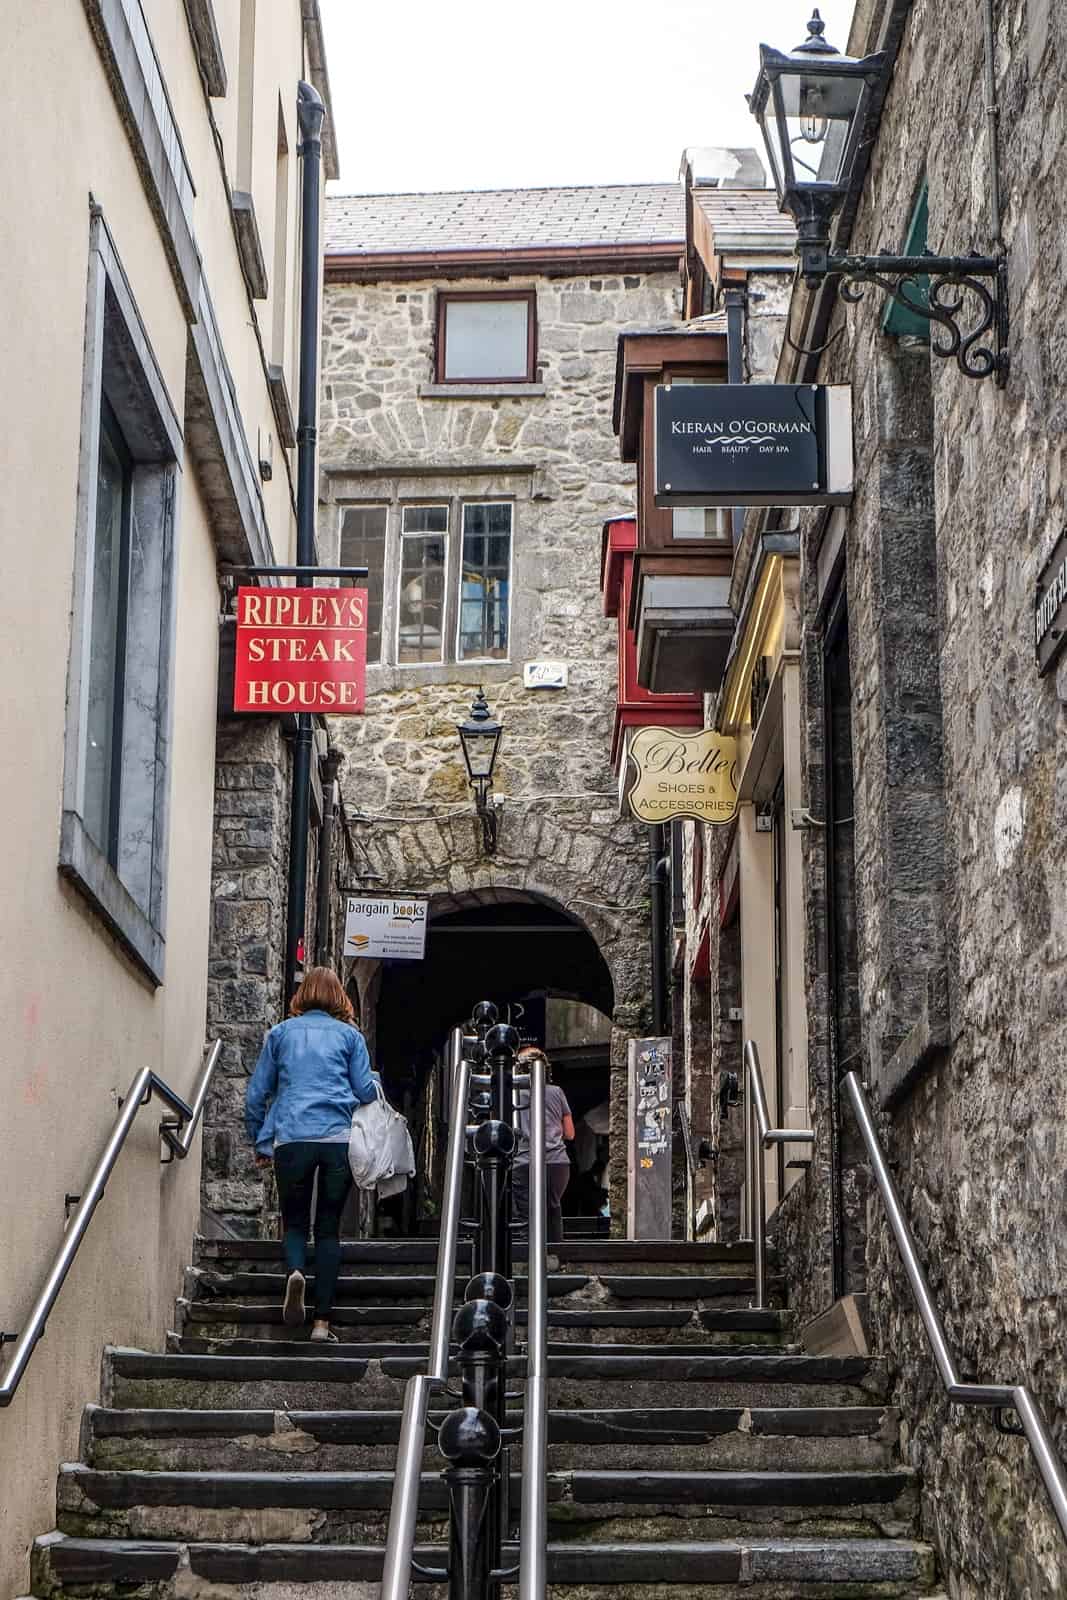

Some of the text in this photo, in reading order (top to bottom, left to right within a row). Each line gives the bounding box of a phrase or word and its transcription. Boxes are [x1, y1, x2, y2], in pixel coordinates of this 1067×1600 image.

[671, 420, 811, 434] KIERAN O'GORMAN
[692, 445, 790, 454] HAIR BEAUTY DAY SPA
[243, 595, 364, 628] RIPLEYS
[248, 638, 355, 662] STEAK
[247, 680, 358, 705] HOUSE
[643, 740, 729, 775] Belle
[657, 782, 716, 794] SHOES &
[638, 798, 735, 811] ACCESSORIES
[348, 899, 425, 917] bargain books
